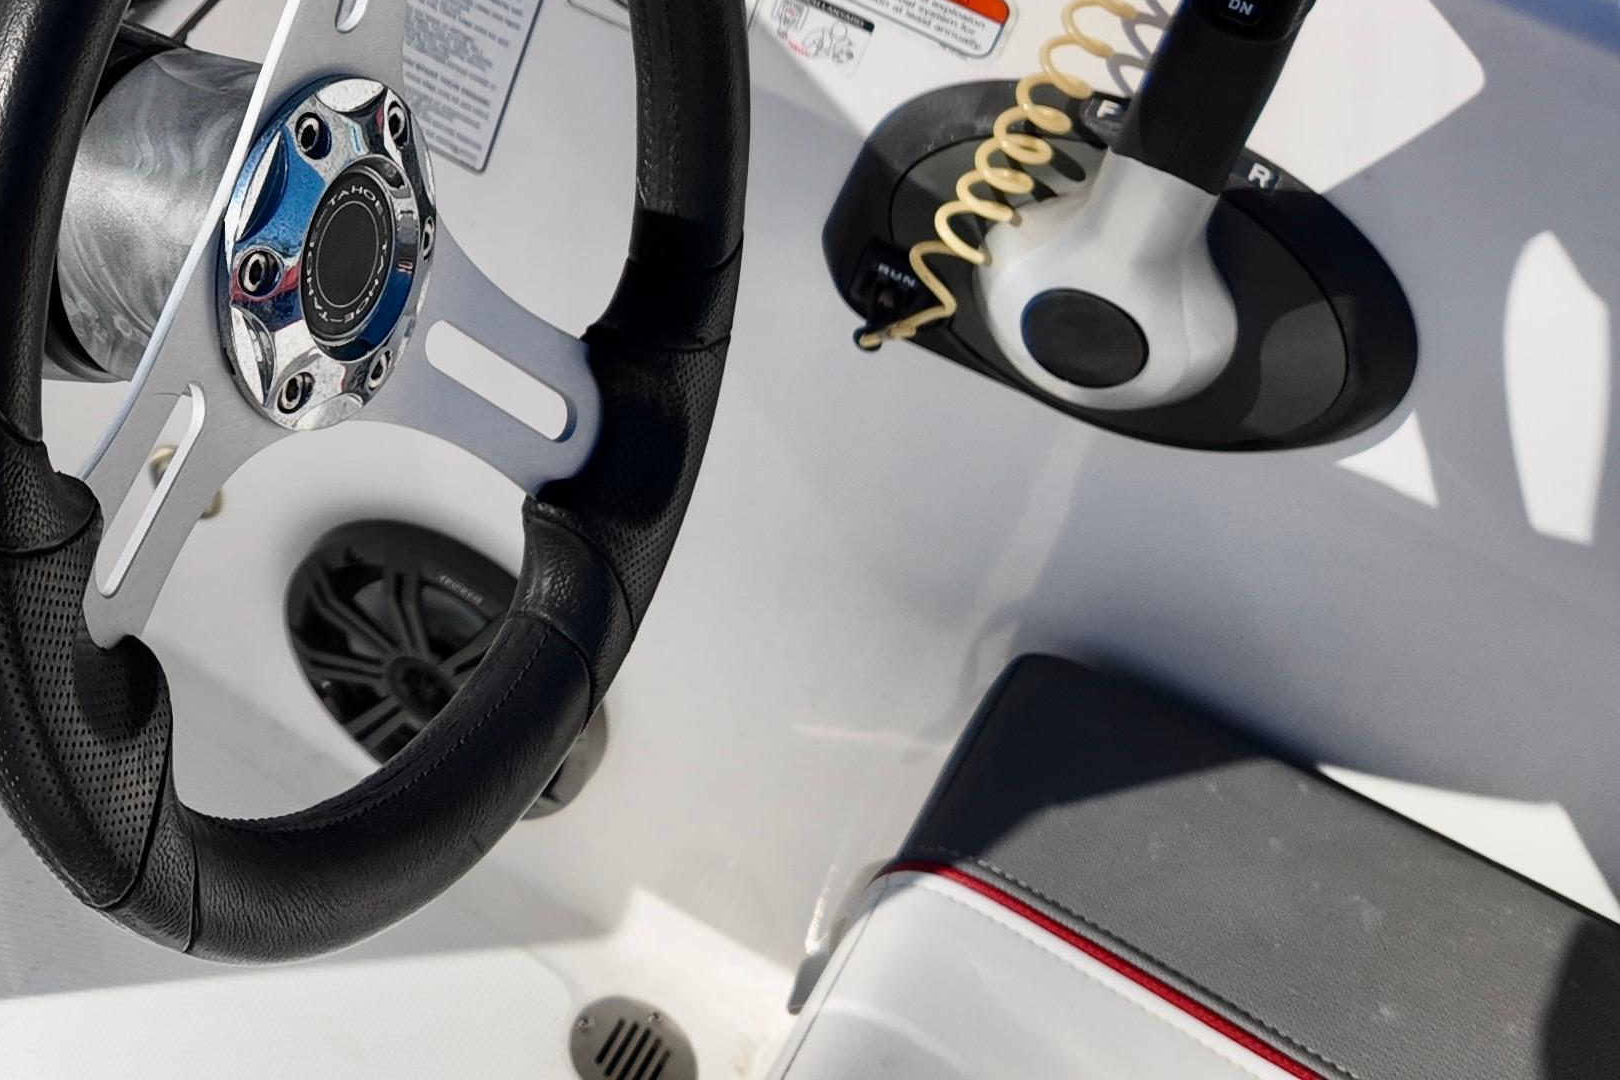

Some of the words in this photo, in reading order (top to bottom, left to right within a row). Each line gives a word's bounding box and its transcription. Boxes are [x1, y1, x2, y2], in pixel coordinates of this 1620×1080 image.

[919, 6, 957, 28] system
[932, 0, 986, 29] explosion
[1096, 99, 1120, 118] F
[1248, 162, 1271, 188] R
[328, 185, 383, 215] TAHOE
[878, 262, 916, 287] RUN
